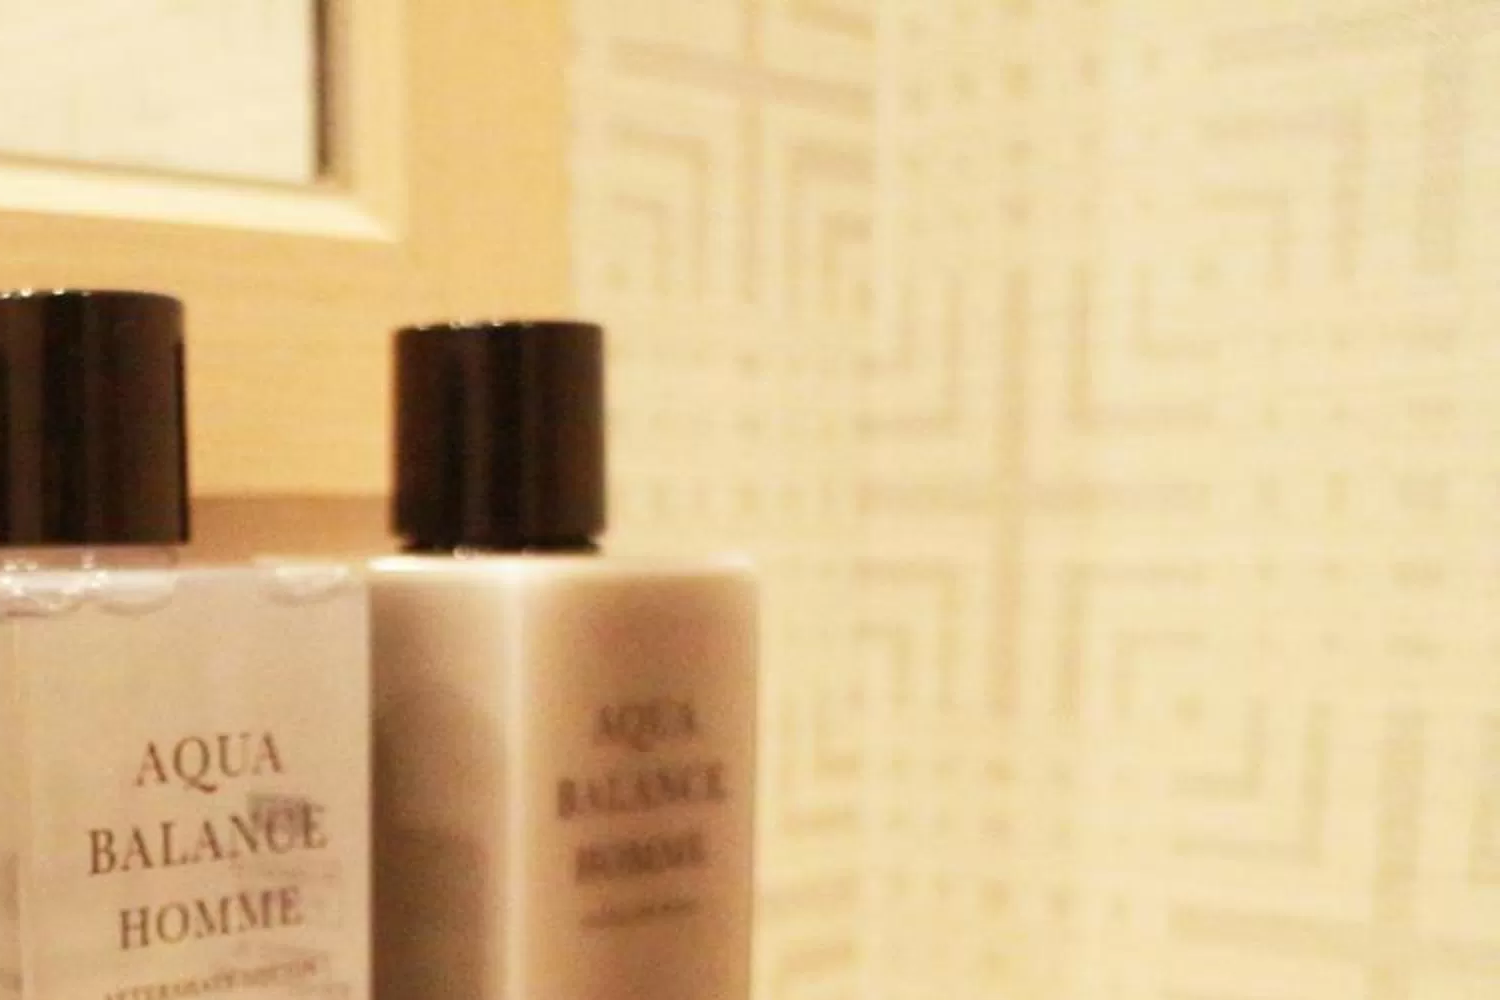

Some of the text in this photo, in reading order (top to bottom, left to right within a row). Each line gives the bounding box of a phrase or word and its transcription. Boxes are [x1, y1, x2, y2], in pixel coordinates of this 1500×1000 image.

[134, 731, 284, 793] AQUA
[86, 801, 329, 877] BALANCE
[117, 885, 304, 951] HOMME
